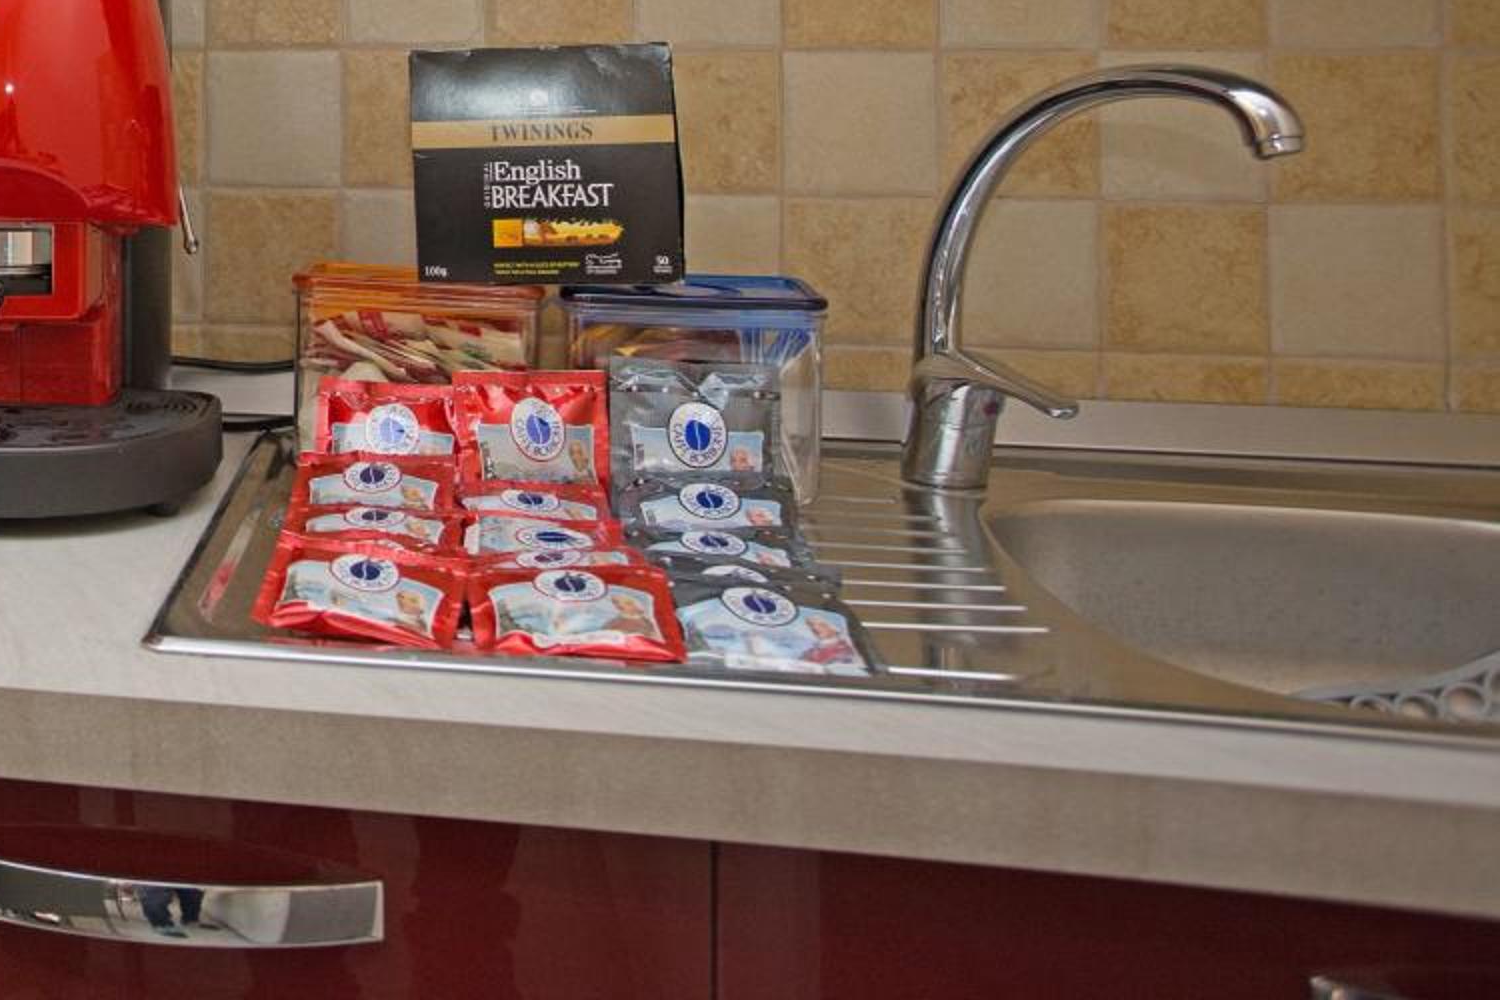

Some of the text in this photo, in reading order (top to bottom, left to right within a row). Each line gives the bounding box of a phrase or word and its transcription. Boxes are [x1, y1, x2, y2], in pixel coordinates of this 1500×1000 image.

[491, 120, 594, 141] TWININGS
[494, 159, 581, 184] English
[492, 183, 615, 209] BREAKFAST
